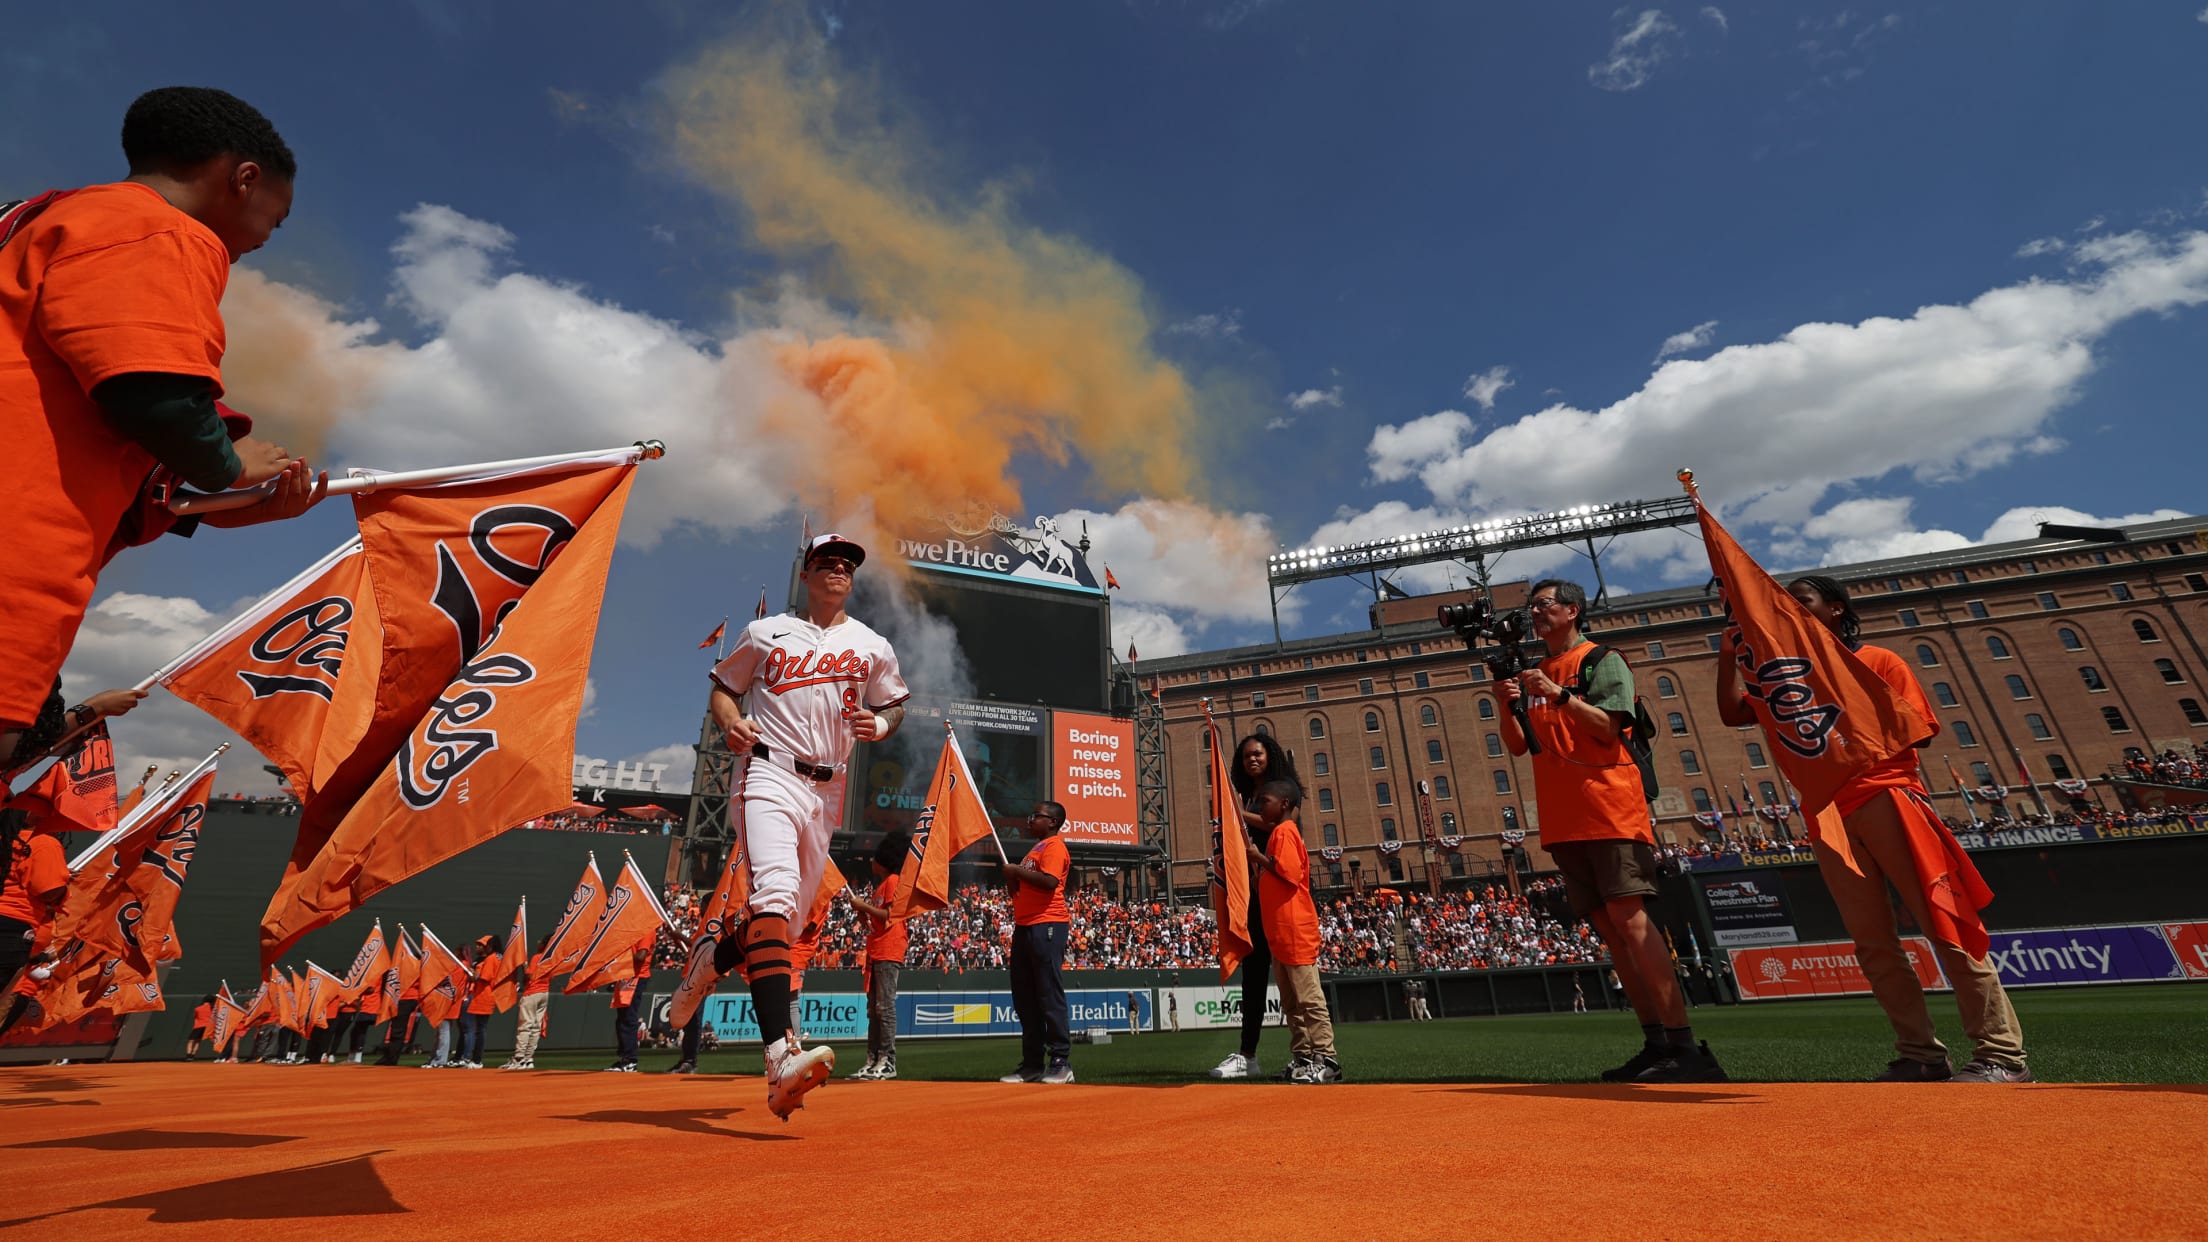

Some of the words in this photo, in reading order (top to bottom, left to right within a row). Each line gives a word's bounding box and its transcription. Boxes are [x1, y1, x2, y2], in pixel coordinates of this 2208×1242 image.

[895, 538, 943, 562] owe
[944, 539, 1010, 572] Price
[764, 647, 869, 687] Orioles
[841, 687, 857, 720] 9
[951, 702, 975, 711] STREAM
[976, 704, 989, 712] MLB
[989, 706, 1018, 715] NETWORK
[962, 710, 981, 718] AUDIO
[982, 711, 999, 719] FROM
[1018, 715, 1038, 723] TEAMS
[1069, 729, 1119, 749] Boring
[1073, 748, 1116, 762] never
[582, 758, 670, 792] GHT
[1069, 764, 1121, 779] misses
[456, 777, 470, 804] TM
[1068, 783, 1078, 794] a
[1083, 781, 1126, 798] pitch.
[1989, 826, 2083, 847] FINANCE
[1741, 851, 1815, 867] Persona
[1706, 888, 1739, 898] College
[1710, 896, 1758, 907] Investment
[1758, 894, 1778, 904] Plan
[1720, 930, 1791, 941] Maryland529.com
[1791, 954, 1859, 970] AUTUM
[1989, 939, 2111, 978] xfinity
[804, 999, 857, 1022] Price
[1071, 1002, 1127, 1020] Health
[718, 1027, 756, 1036] INVEST
[799, 1026, 857, 1035] ONFIDENCE
